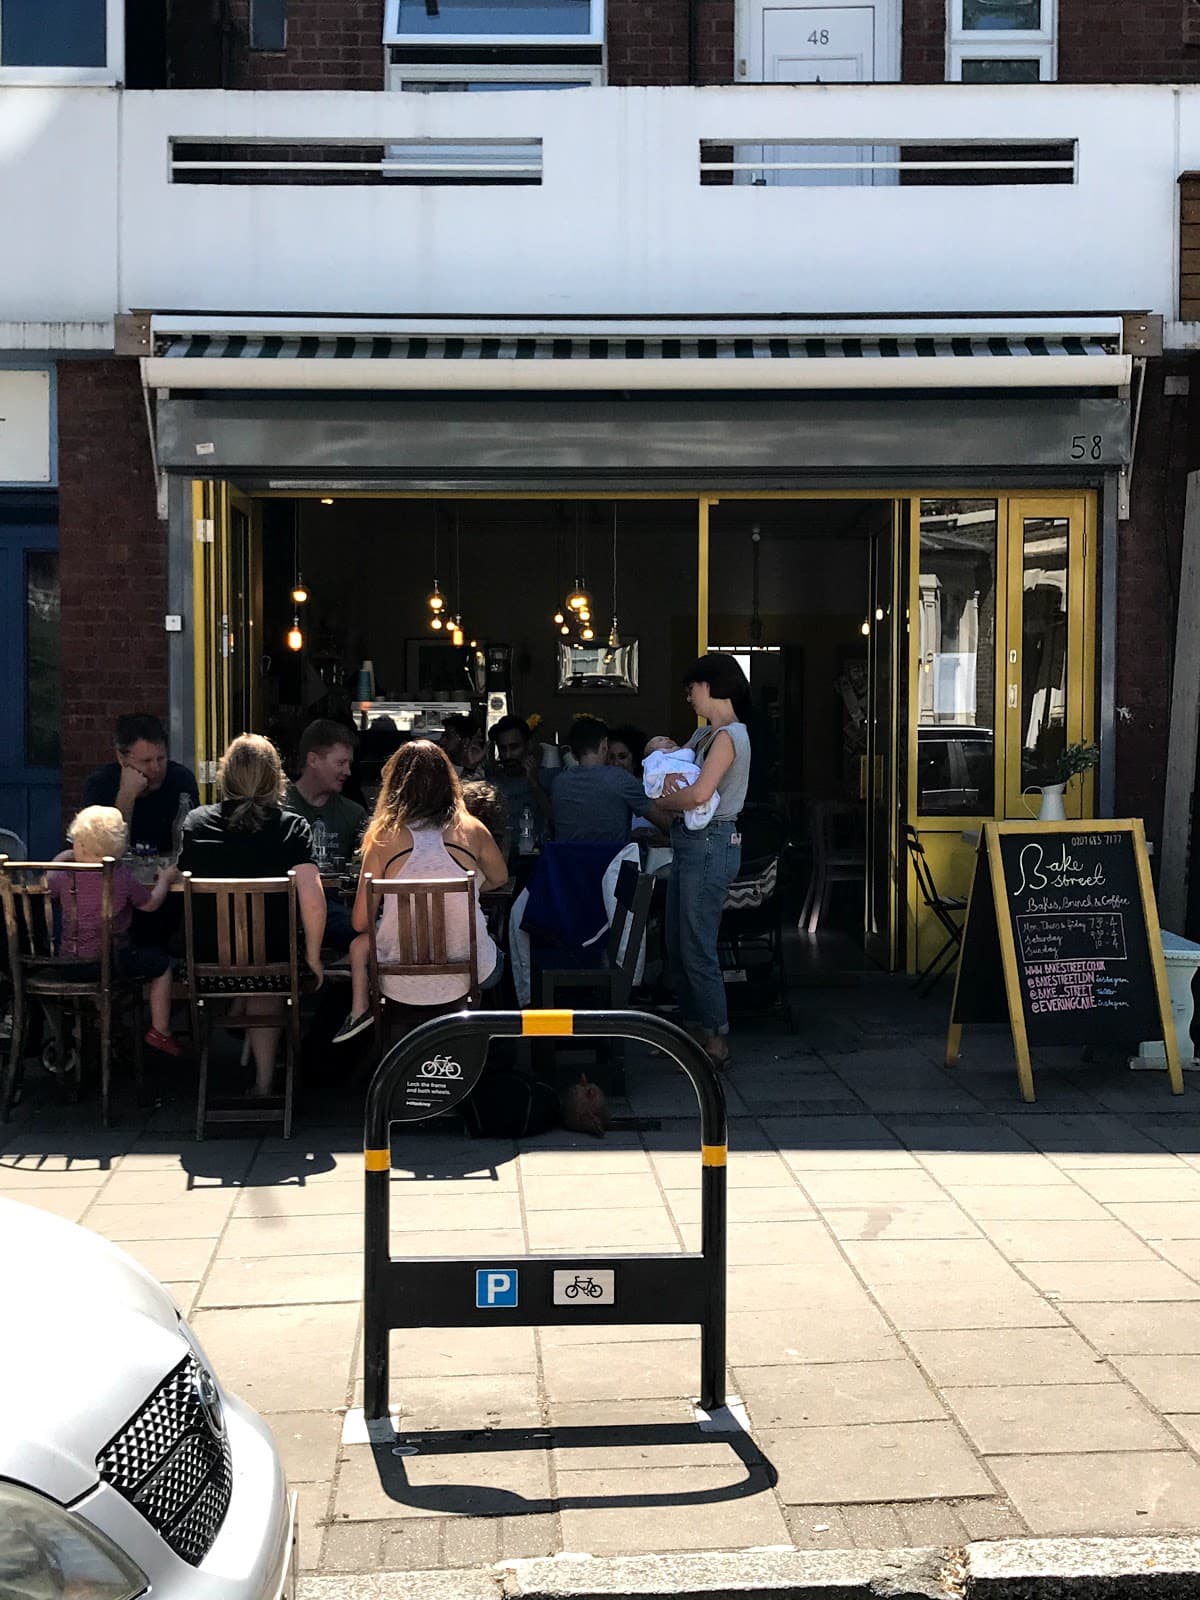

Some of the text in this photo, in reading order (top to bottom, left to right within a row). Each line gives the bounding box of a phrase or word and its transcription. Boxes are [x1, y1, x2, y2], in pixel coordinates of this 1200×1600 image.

[807, 29, 830, 45] 48
[1071, 435, 1102, 460] 58
[1013, 843, 1084, 895] Bake
[487, 1274, 511, 1304] P
